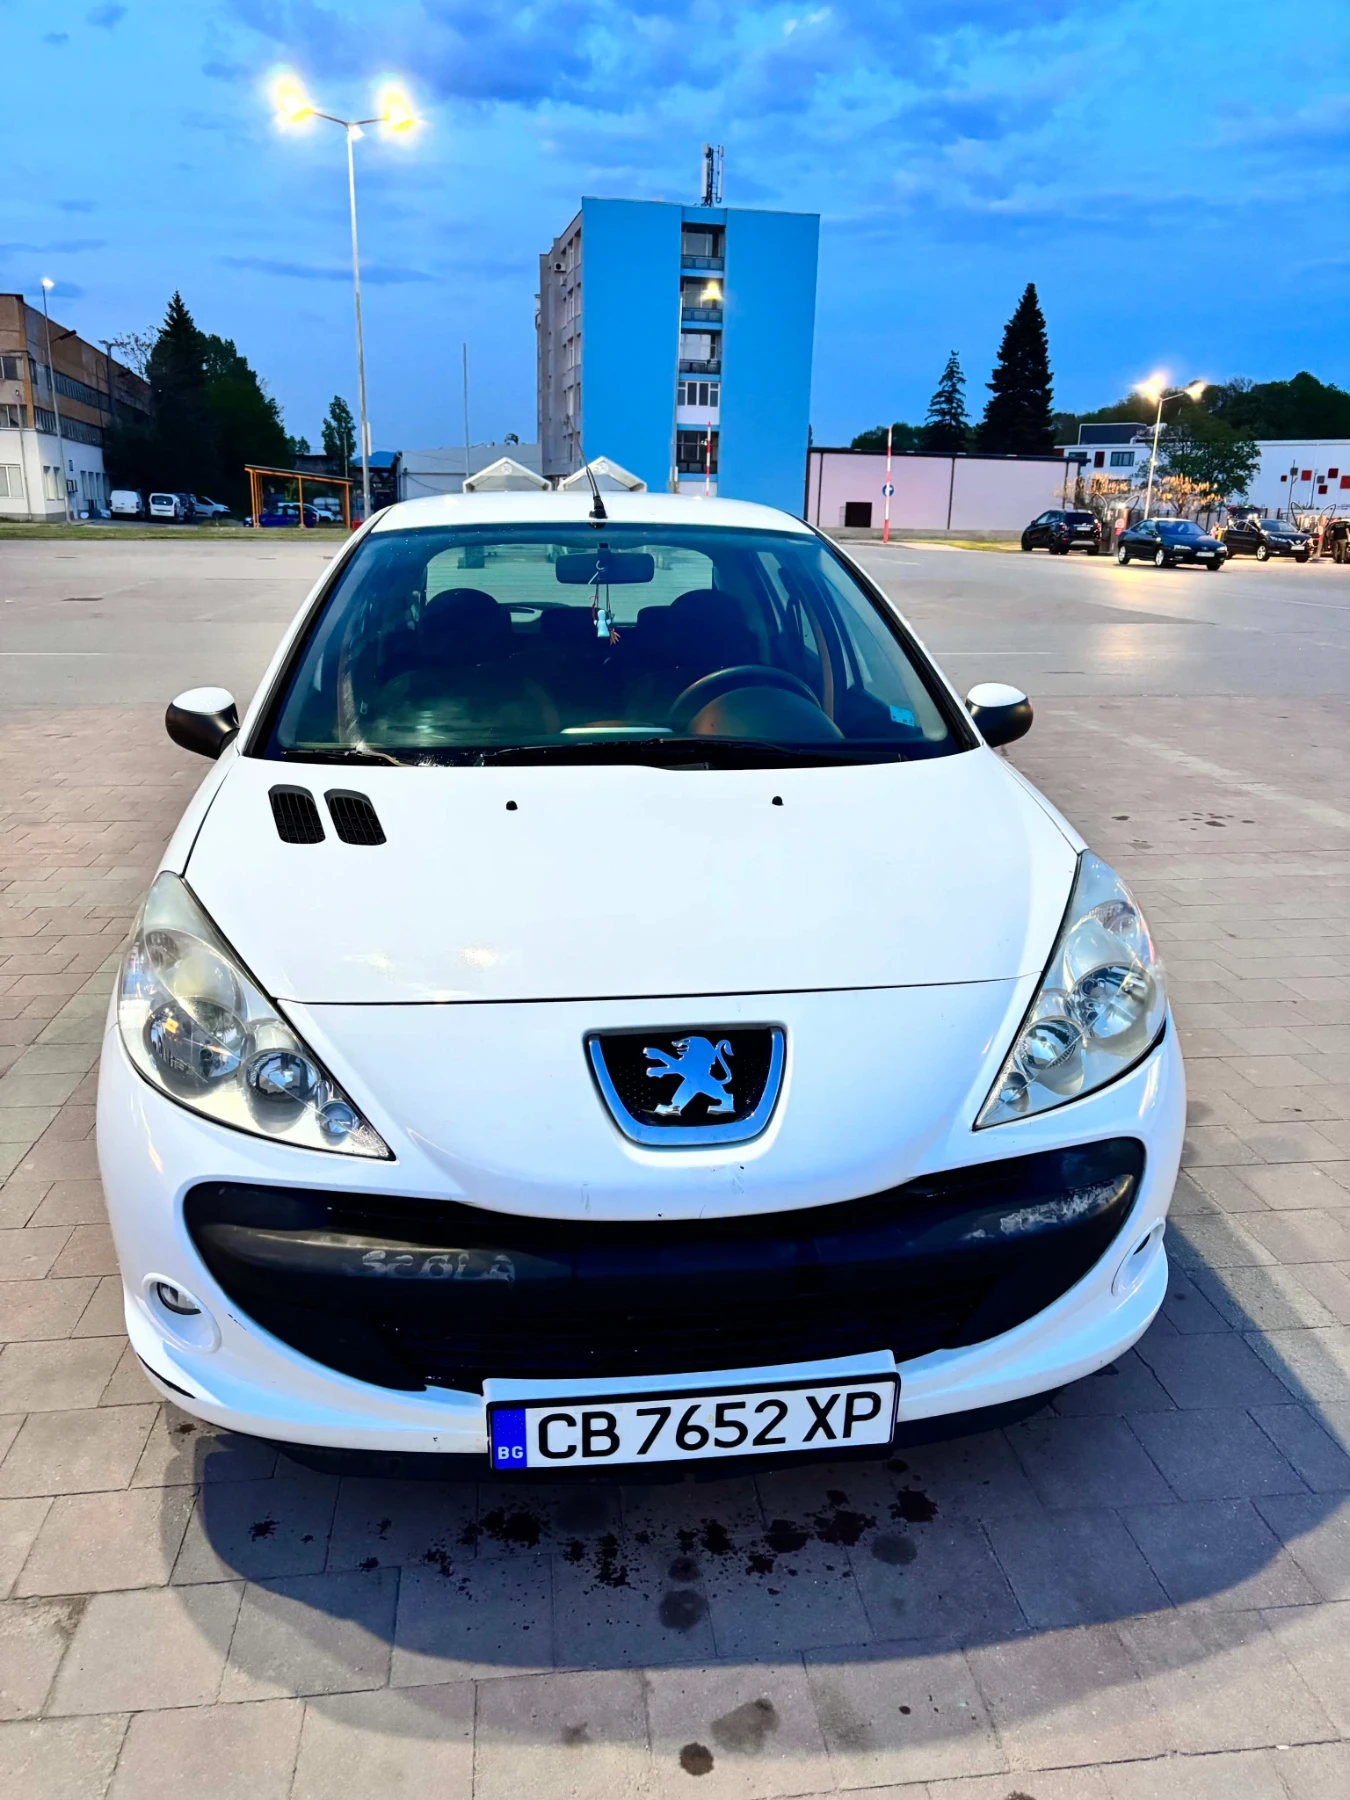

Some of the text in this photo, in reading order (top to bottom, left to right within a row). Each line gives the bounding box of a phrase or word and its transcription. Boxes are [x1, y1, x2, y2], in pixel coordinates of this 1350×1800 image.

[538, 1391, 882, 1460] CB 7652 XP
[497, 1445, 524, 1460] BG
